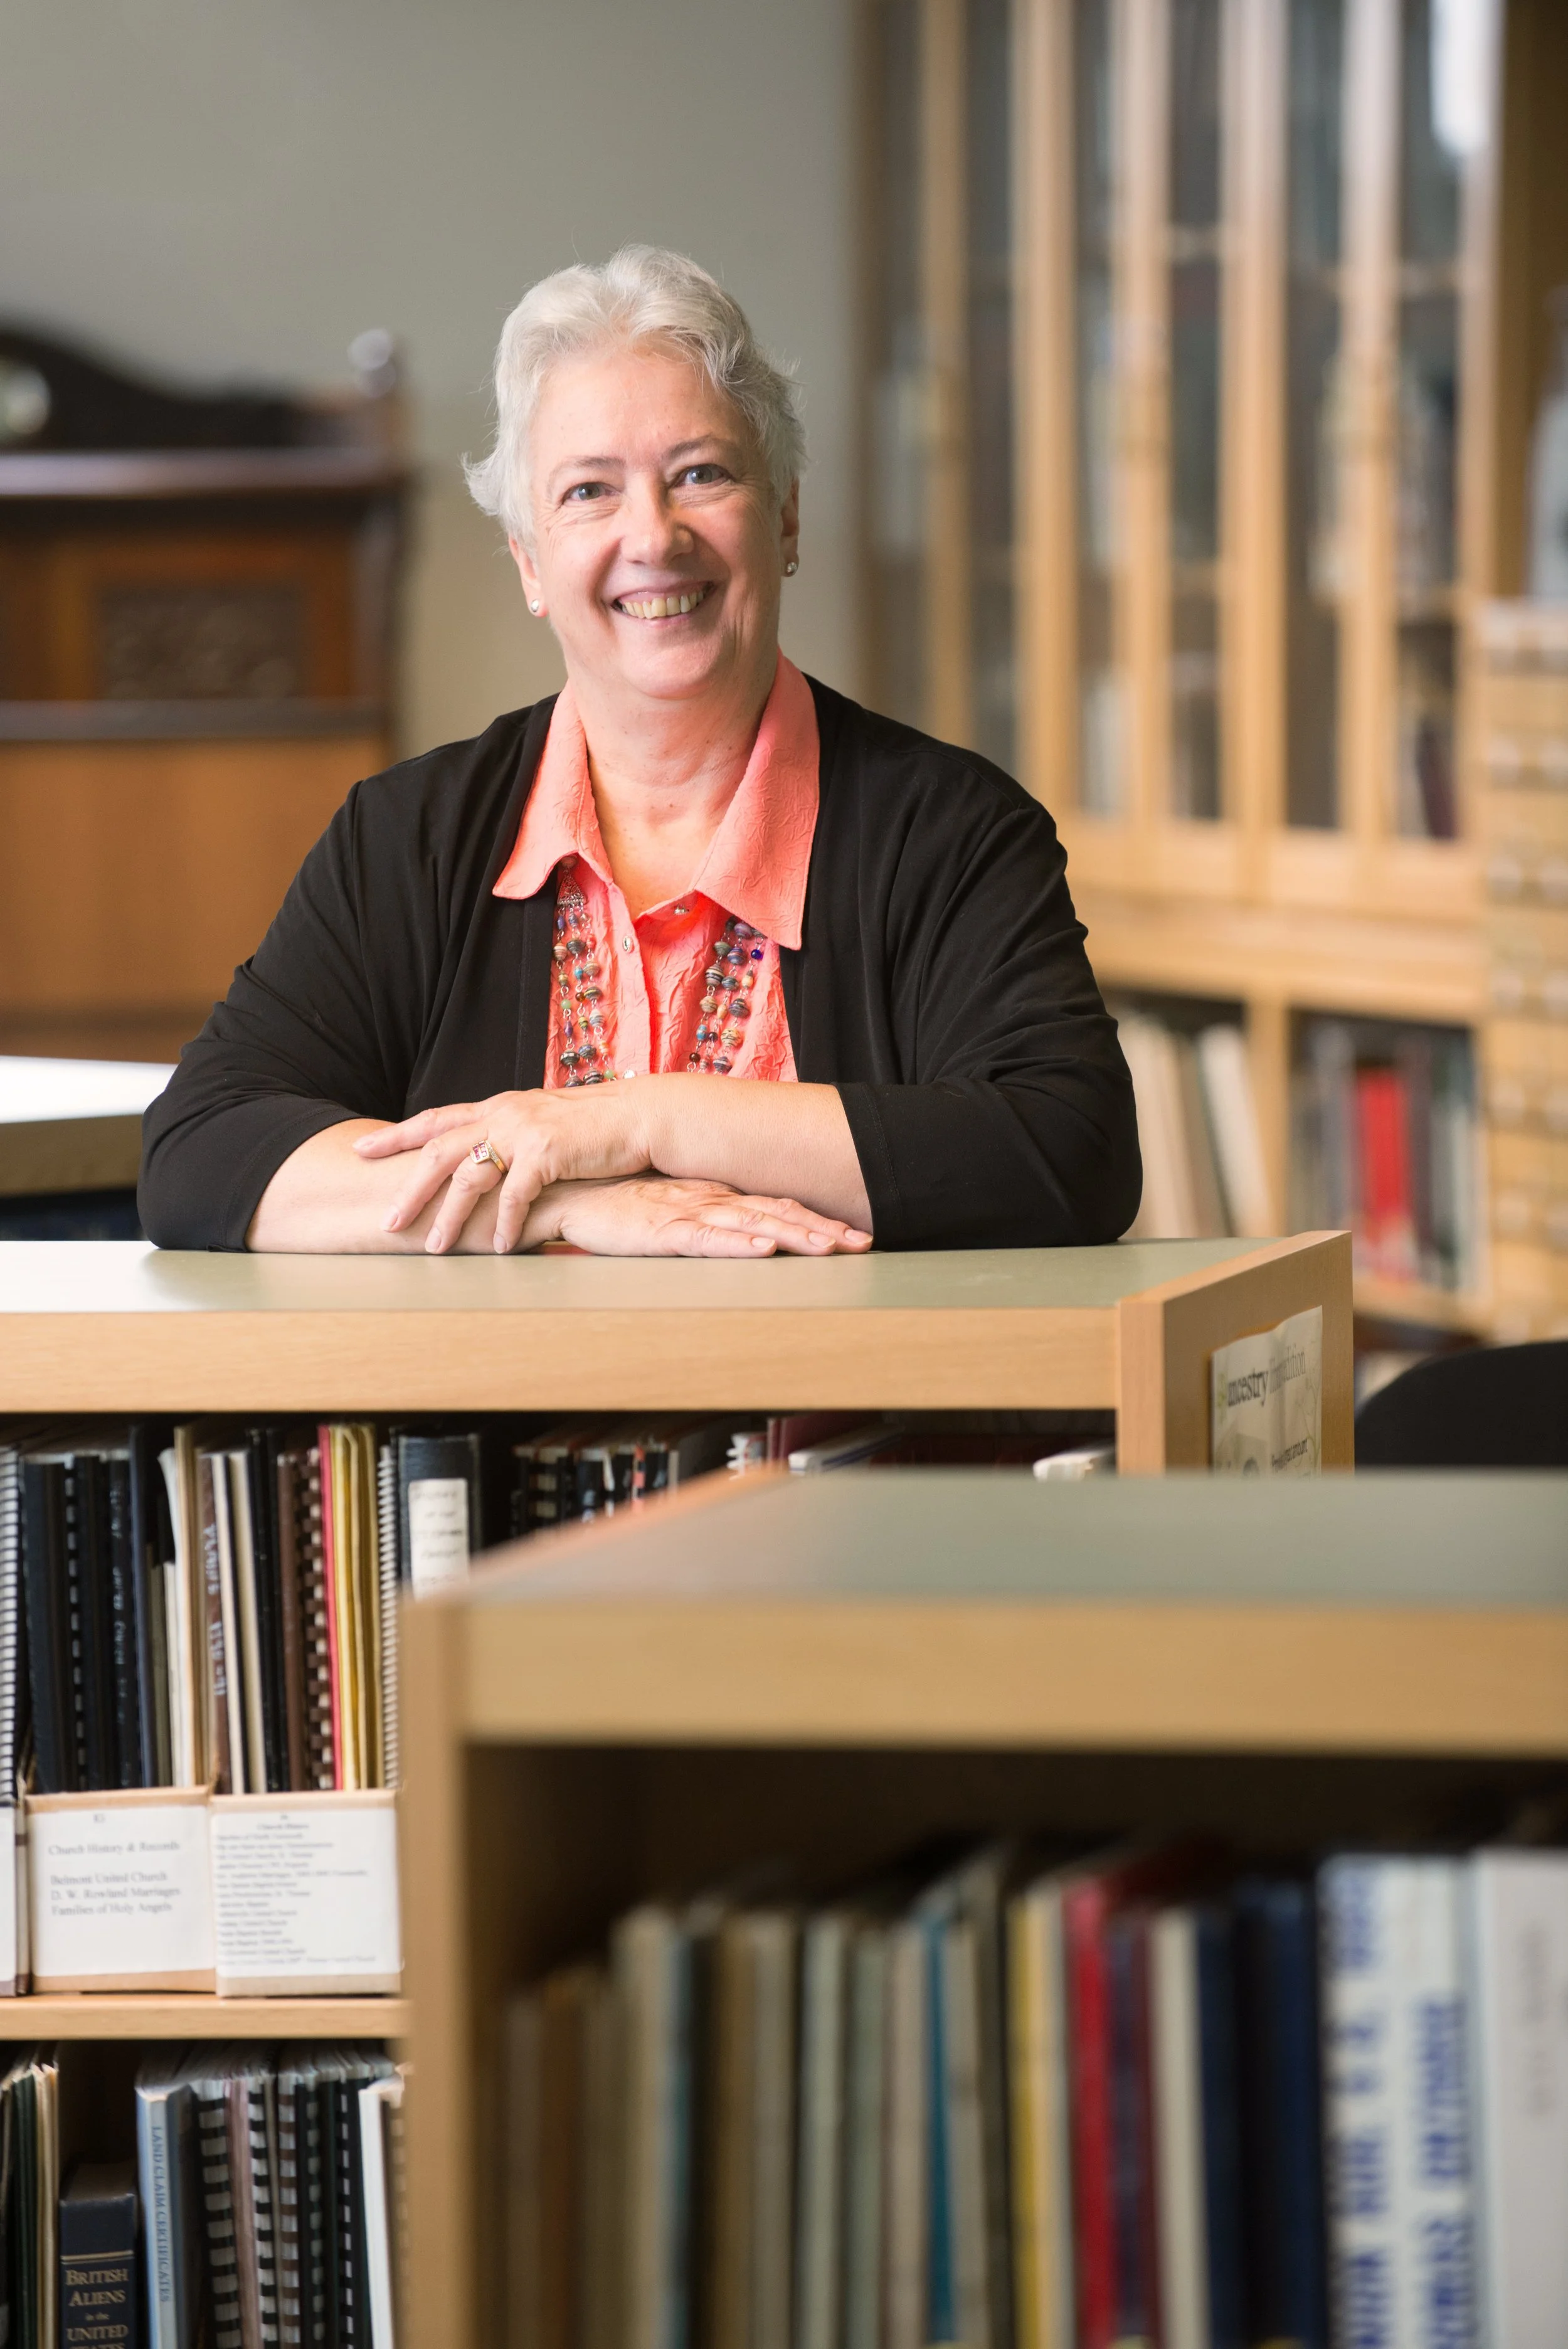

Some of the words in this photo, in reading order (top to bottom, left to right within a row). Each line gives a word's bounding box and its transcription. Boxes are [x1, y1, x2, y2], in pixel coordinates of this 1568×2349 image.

[1227, 1368, 1269, 1408] ancestry
[48, 1844, 85, 1855] Church
[87, 1843, 124, 1855] History
[127, 1842, 135, 1852] &
[139, 1840, 181, 1852] Records
[95, 1872, 129, 1884] United
[131, 1870, 168, 1882] Church
[131, 1887, 181, 1899] Marriages
[51, 1904, 93, 1916] Families
[96, 1902, 108, 1914] of
[152, 2126, 163, 2163] LAND
[154, 2165, 166, 2207] CLAIM
[157, 2211, 170, 2302] CERTIFICATES
[65, 2268, 129, 2286] BRITISH
[65, 2324, 129, 2341] UNITED
